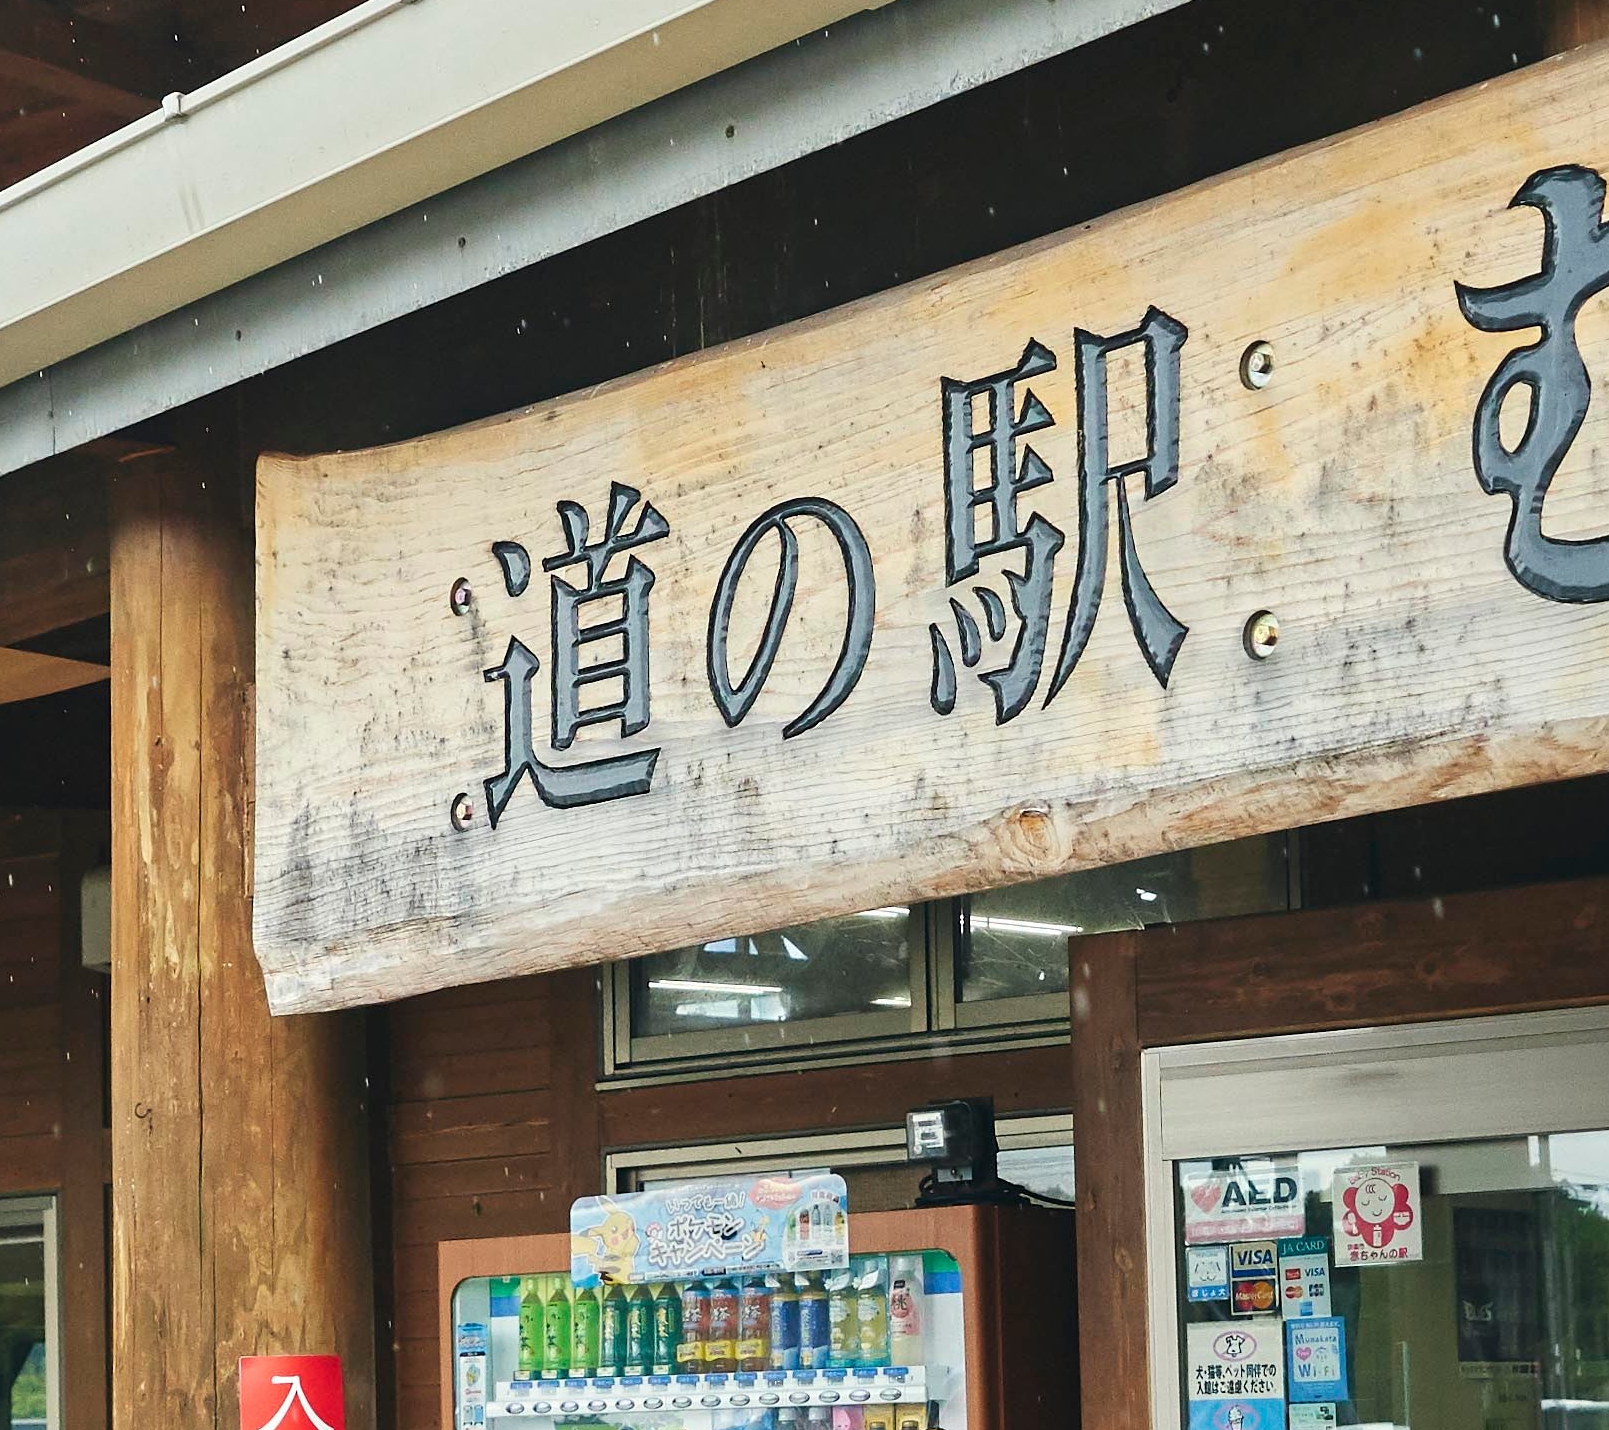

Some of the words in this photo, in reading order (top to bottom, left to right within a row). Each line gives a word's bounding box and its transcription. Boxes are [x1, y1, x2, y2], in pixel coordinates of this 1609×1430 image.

[480, 303, 1191, 831] 道の駅
[1221, 1177, 1298, 1208] AED
[648, 1235, 767, 1267] キャンペーン
[1280, 1243, 1293, 1255] JA
[1295, 1240, 1326, 1253] CARD
[1349, 1247, 1409, 1262] 赤ちゃんの駅
[1238, 1248, 1274, 1266] VISA
[1305, 1268, 1326, 1278] VISA
[1295, 1333, 1338, 1346] Munakata
[1298, 1364, 1335, 1378] Wi-Fi
